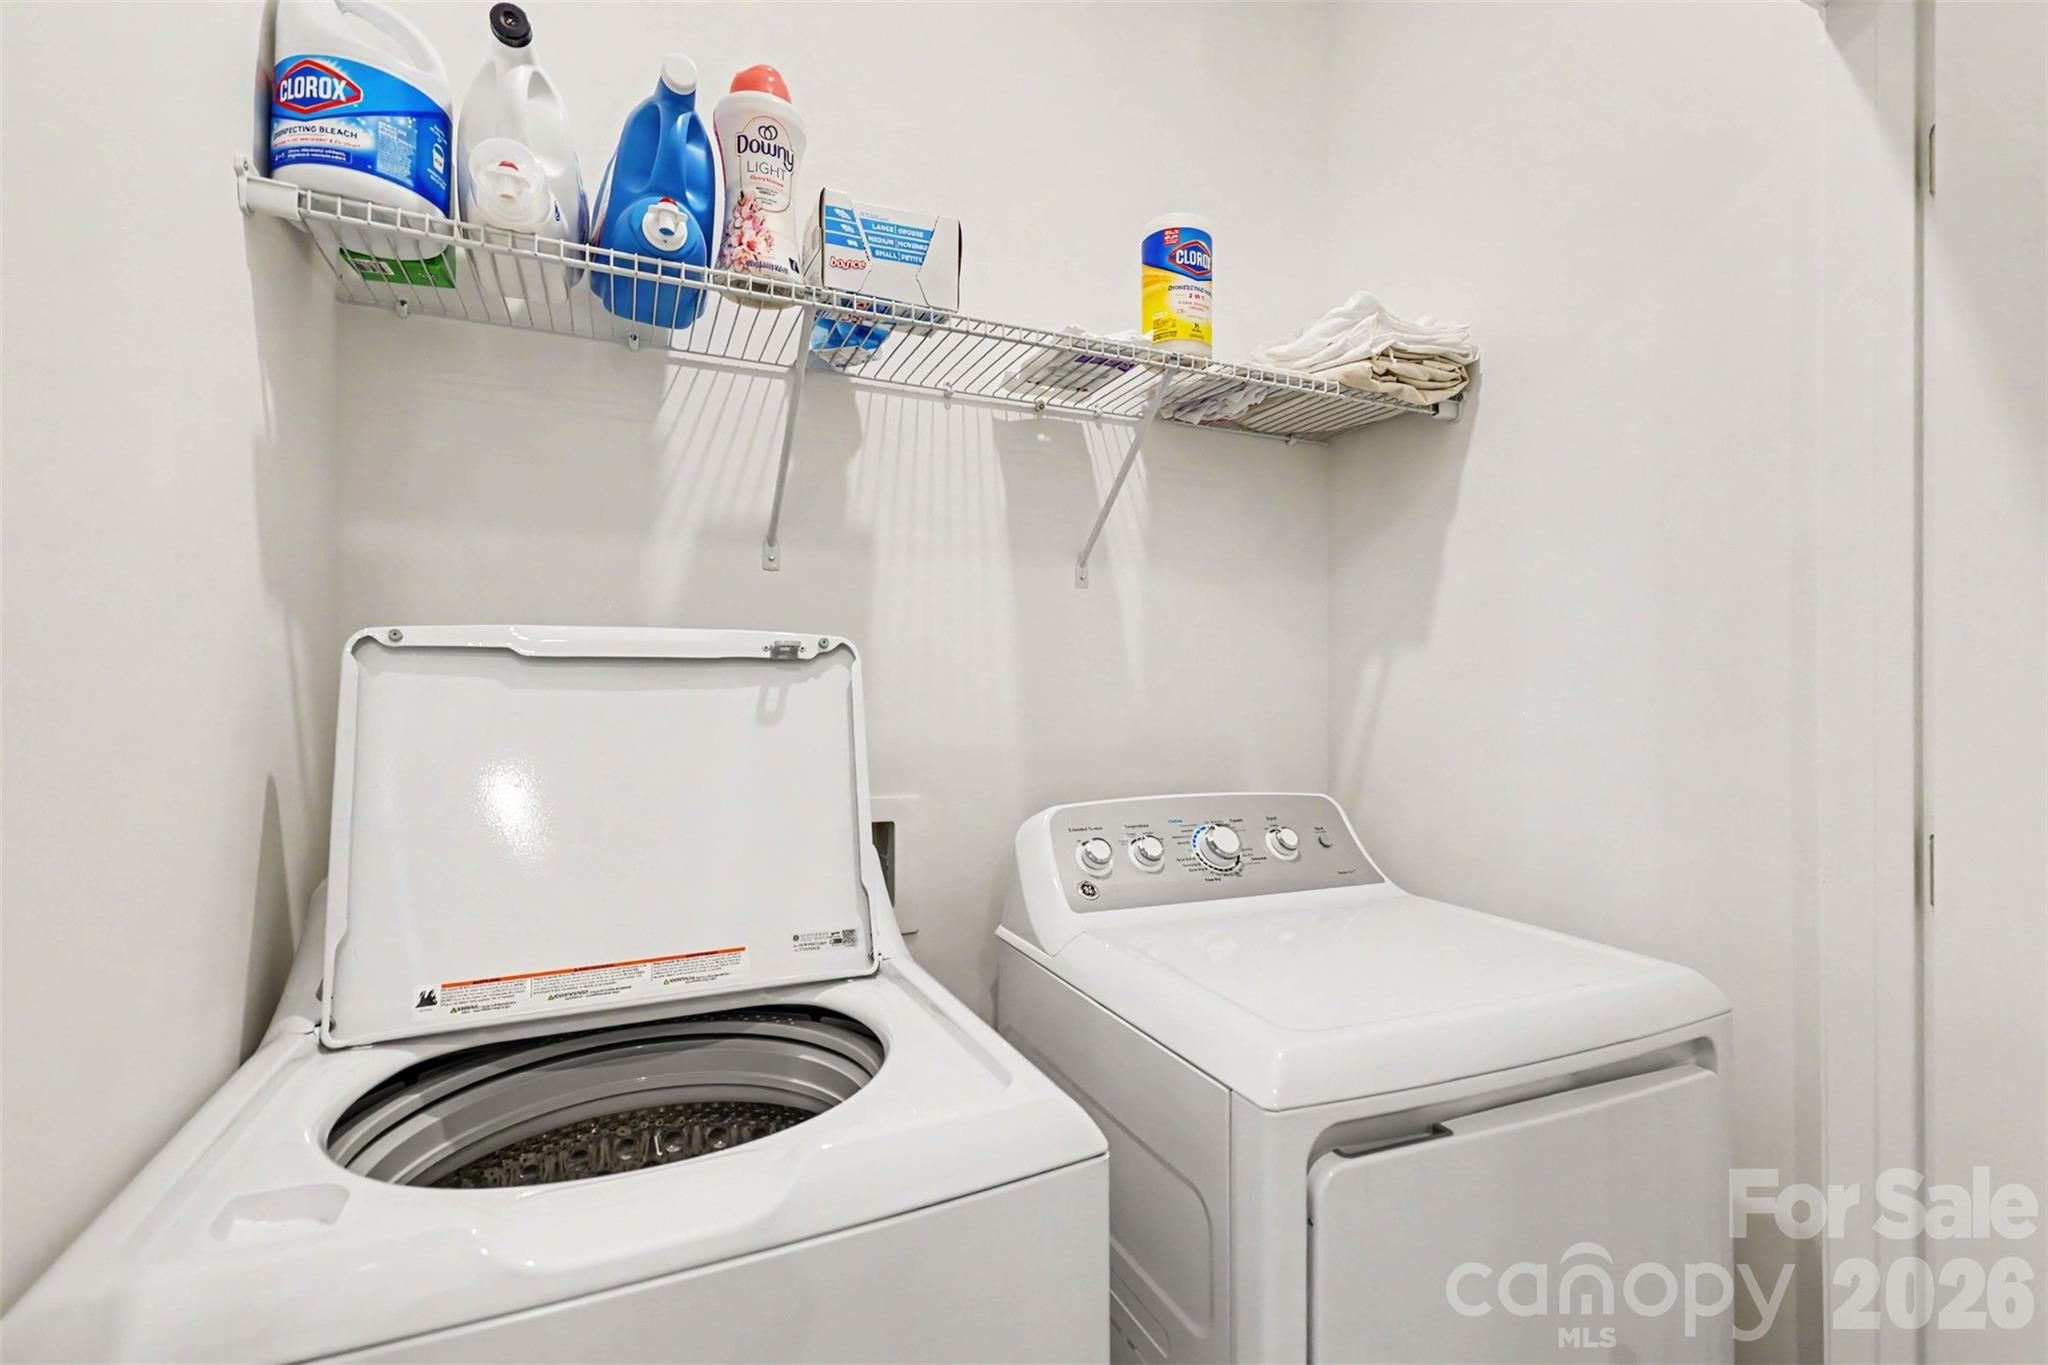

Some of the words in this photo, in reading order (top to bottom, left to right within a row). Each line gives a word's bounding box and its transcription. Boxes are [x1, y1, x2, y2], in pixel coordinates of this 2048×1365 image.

[279, 76, 347, 102] CLOROX
[319, 126, 358, 139] BLEACH
[737, 134, 794, 172] Downy
[747, 161, 786, 180] LIGHT
[829, 256, 866, 270] bounce
[875, 249, 898, 260] SMALL
[1176, 249, 1211, 270] CLORO
